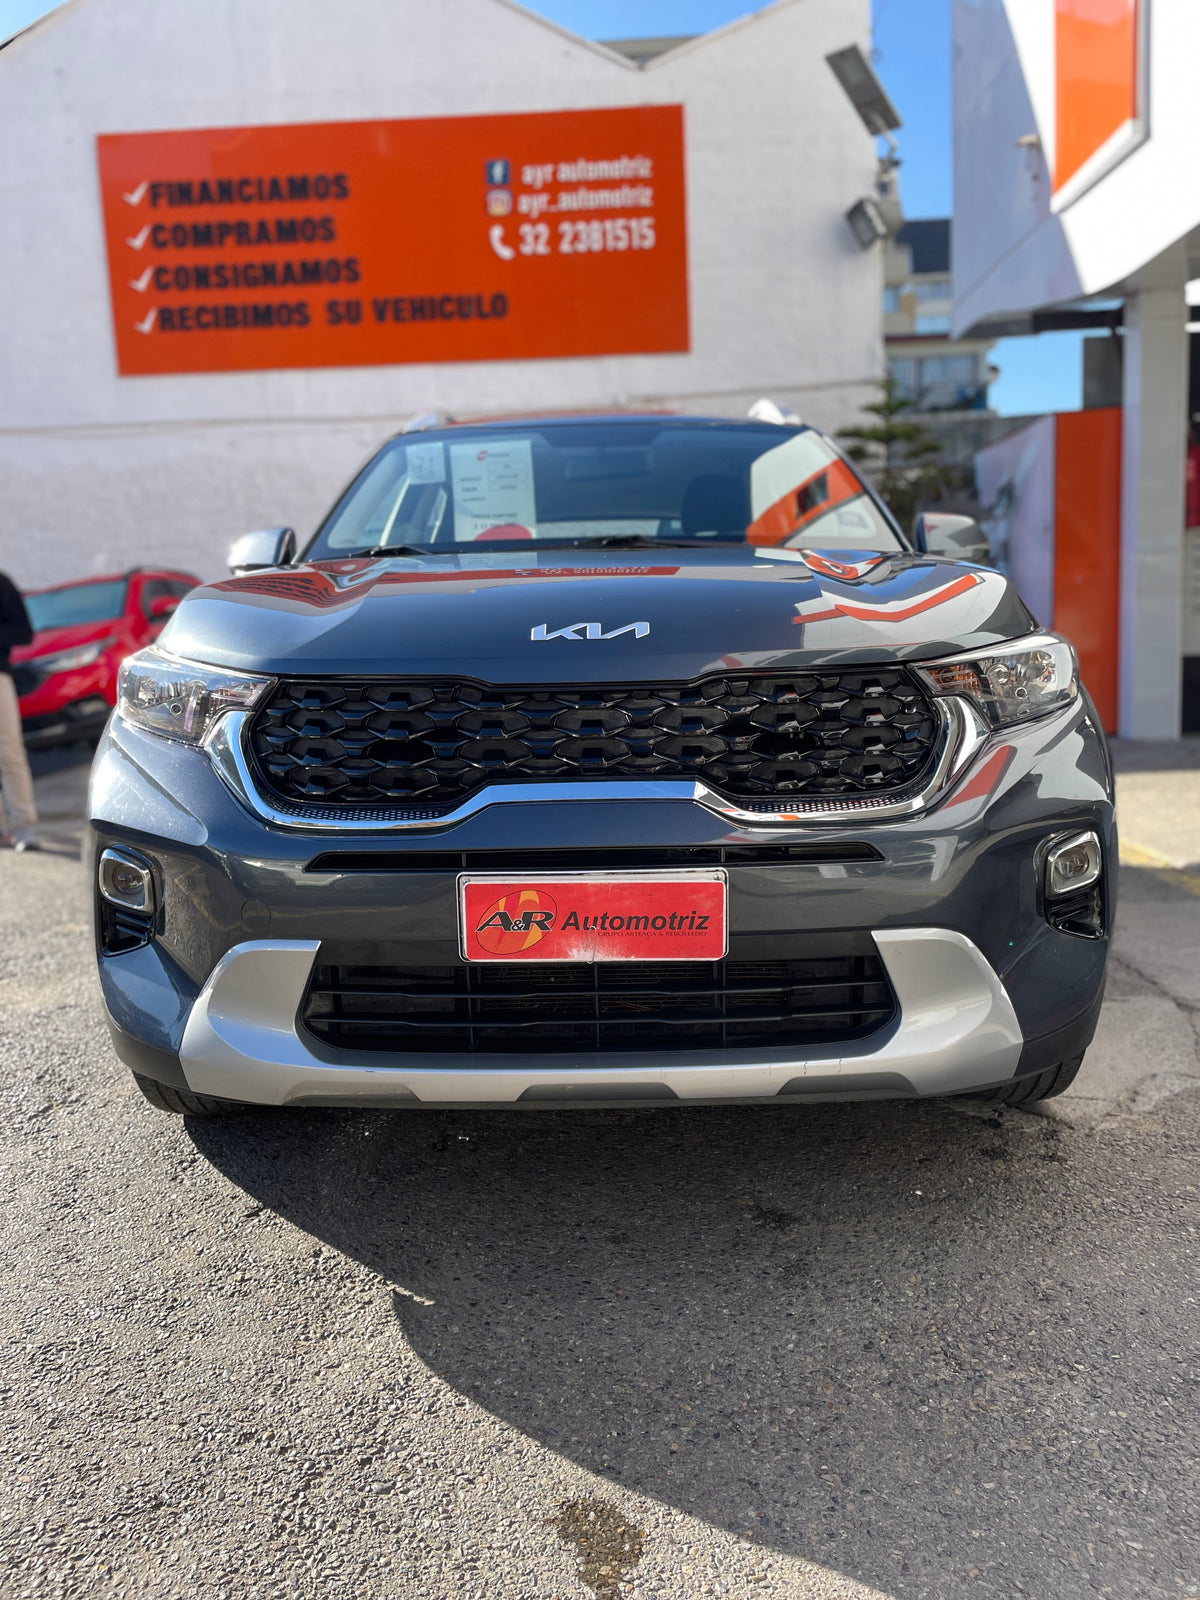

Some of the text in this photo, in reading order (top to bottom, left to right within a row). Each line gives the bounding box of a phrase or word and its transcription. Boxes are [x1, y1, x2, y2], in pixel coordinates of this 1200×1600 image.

[521, 154, 653, 190] ayr automotriz
[150, 173, 351, 207] FINANCIAMOS
[151, 217, 336, 249] COMPRAMOS
[518, 217, 656, 256] 32 2381515
[154, 257, 360, 292] CONSIGNAMOS
[159, 291, 508, 333] RECIBIMOS SU VEHICULO
[531, 621, 650, 641] KIA
[475, 910, 710, 933] A&R Automotriz
